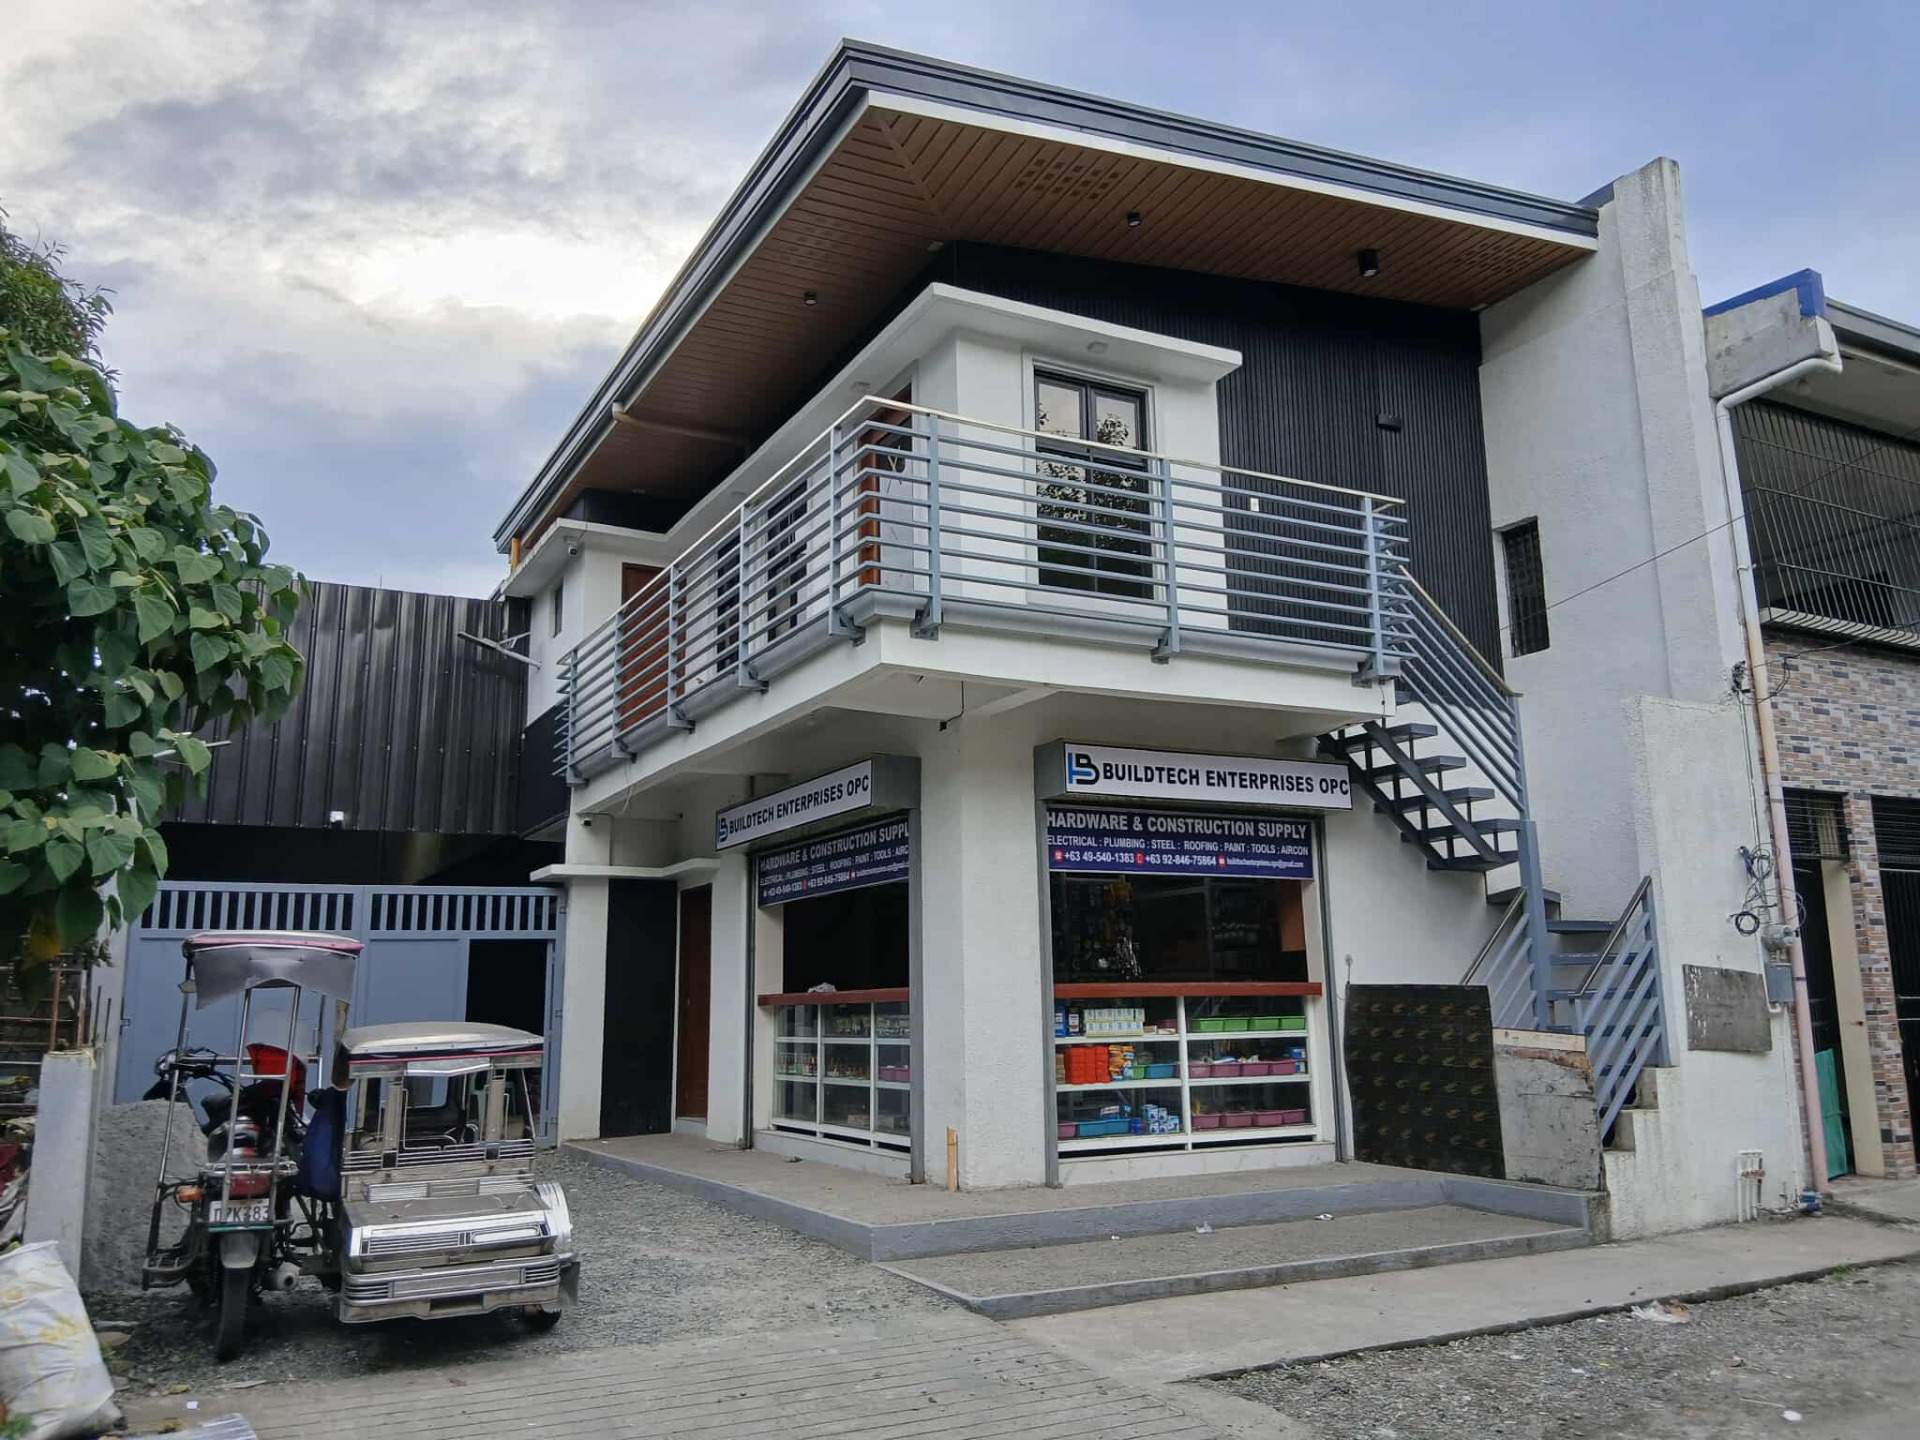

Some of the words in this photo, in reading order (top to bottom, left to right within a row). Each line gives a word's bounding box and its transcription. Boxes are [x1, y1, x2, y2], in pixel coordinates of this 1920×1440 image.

[1103, 762, 1200, 786] BUILDTECH
[1206, 769, 1314, 793] ENTERPRISES
[1319, 777, 1349, 796] OPC
[729, 807, 774, 834] BUILDTECH
[777, 783, 843, 819] ENTERPRISES
[847, 774, 870, 796] OPC
[810, 828, 877, 859] CONSTRUCTION
[879, 821, 909, 844] SUPPL
[1047, 811, 1128, 831] HARDWARE
[1133, 816, 1143, 832] &
[1147, 817, 1255, 837] CONSTRUCTION
[1258, 822, 1307, 840] SUPPLY
[1047, 835, 1098, 847] ELECTRICAL
[1104, 837, 1145, 849] PLUMBING
[1151, 839, 1176, 850] STEEL
[1184, 840, 1219, 852] ROOFING
[1224, 842, 1245, 853] PAINT
[1251, 843, 1276, 854] TOOLS
[1281, 845, 1309, 856] AIRCON
